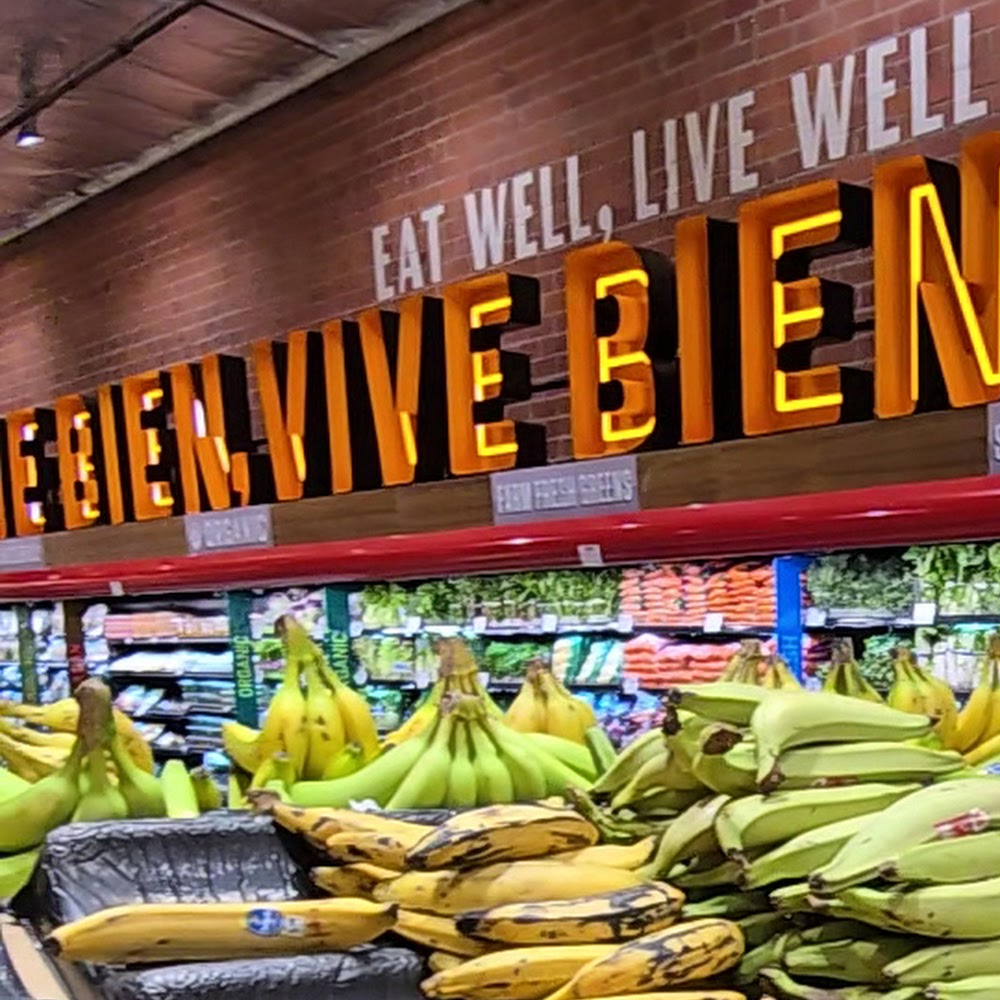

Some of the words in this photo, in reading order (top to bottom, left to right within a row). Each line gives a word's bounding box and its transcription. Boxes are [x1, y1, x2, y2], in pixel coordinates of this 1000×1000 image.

[371, 201, 446, 301] EAT
[462, 154, 614, 271] WELL,
[632, 89, 761, 222] LIVE
[789, 9, 990, 170] WELL
[249, 268, 522, 501] VIVE
[232, 634, 254, 699] ORGANIC
